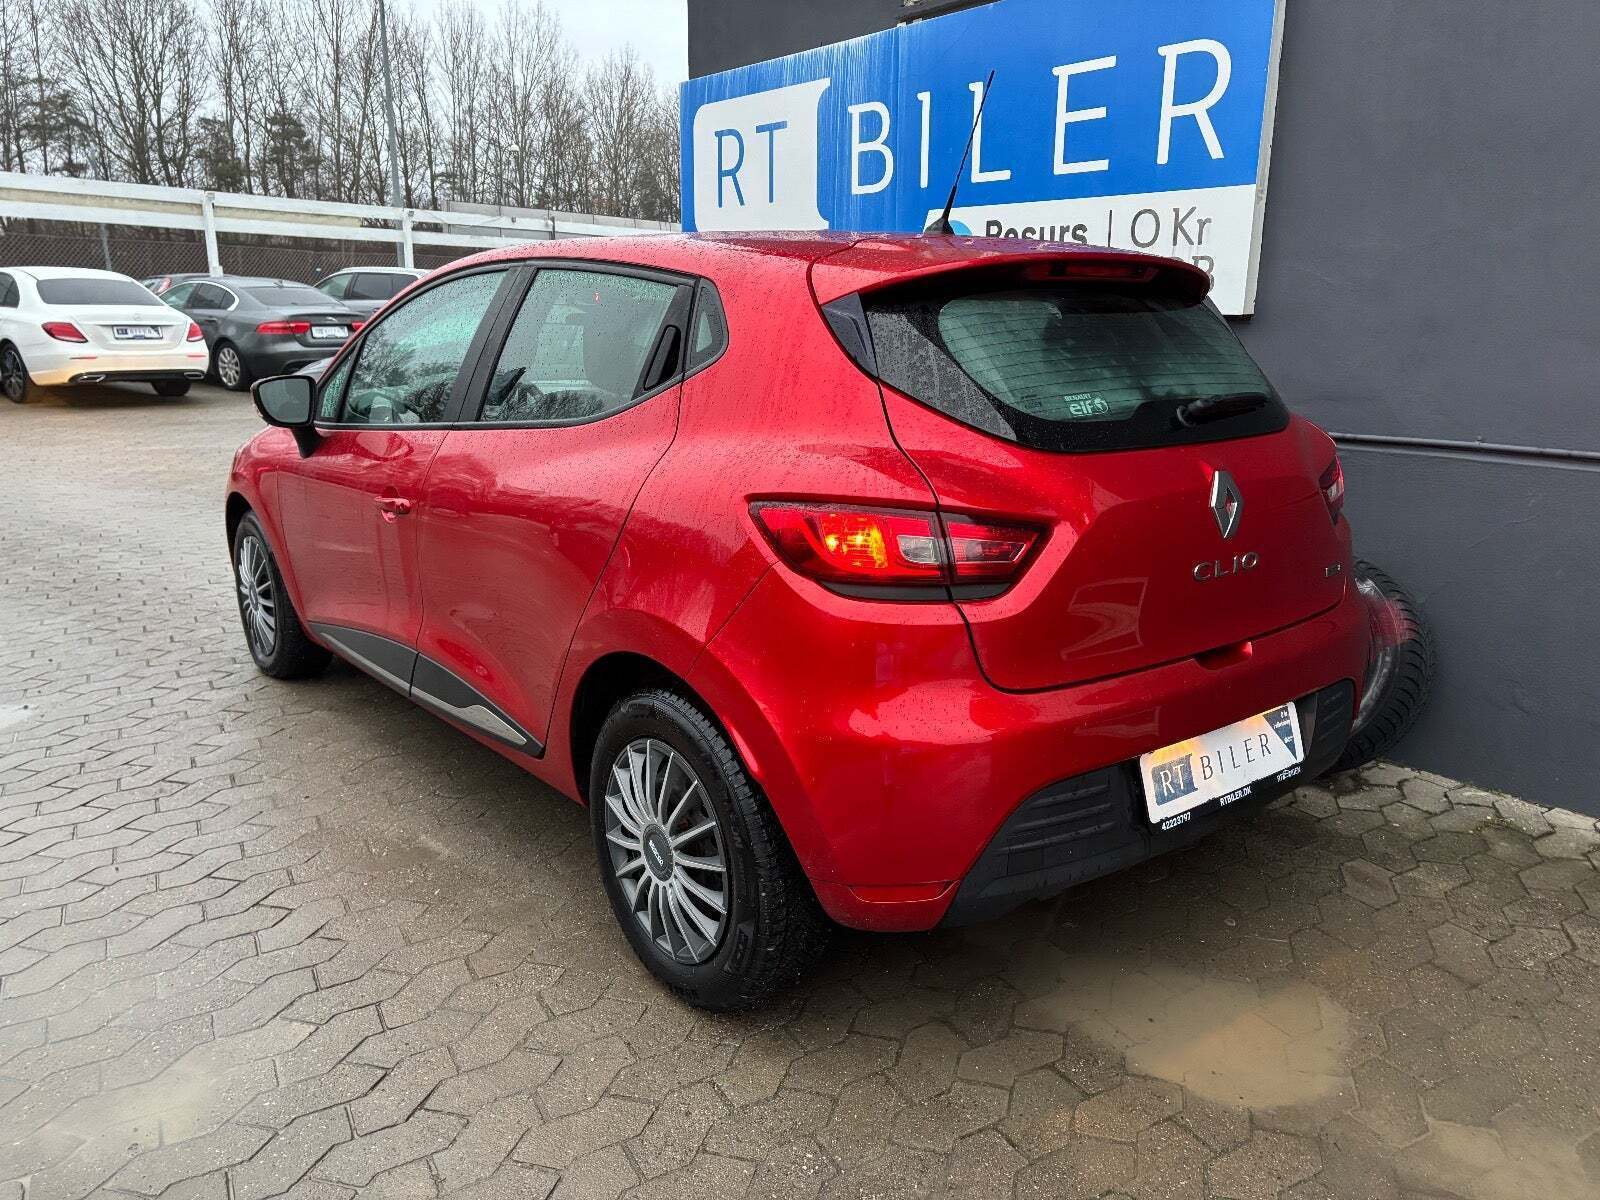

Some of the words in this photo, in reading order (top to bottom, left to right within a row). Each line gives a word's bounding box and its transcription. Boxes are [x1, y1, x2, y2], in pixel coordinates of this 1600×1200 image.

[714, 120, 788, 208] RT
[847, 38, 1232, 195] BILER
[1172, 206, 1213, 247] Kr
[1192, 552, 1258, 582] CLIO
[1159, 763, 1186, 797] RT
[1199, 733, 1272, 781] BILER
[1219, 785, 1252, 807] RTBILER.DK
[1161, 811, 1191, 831] 42223797
